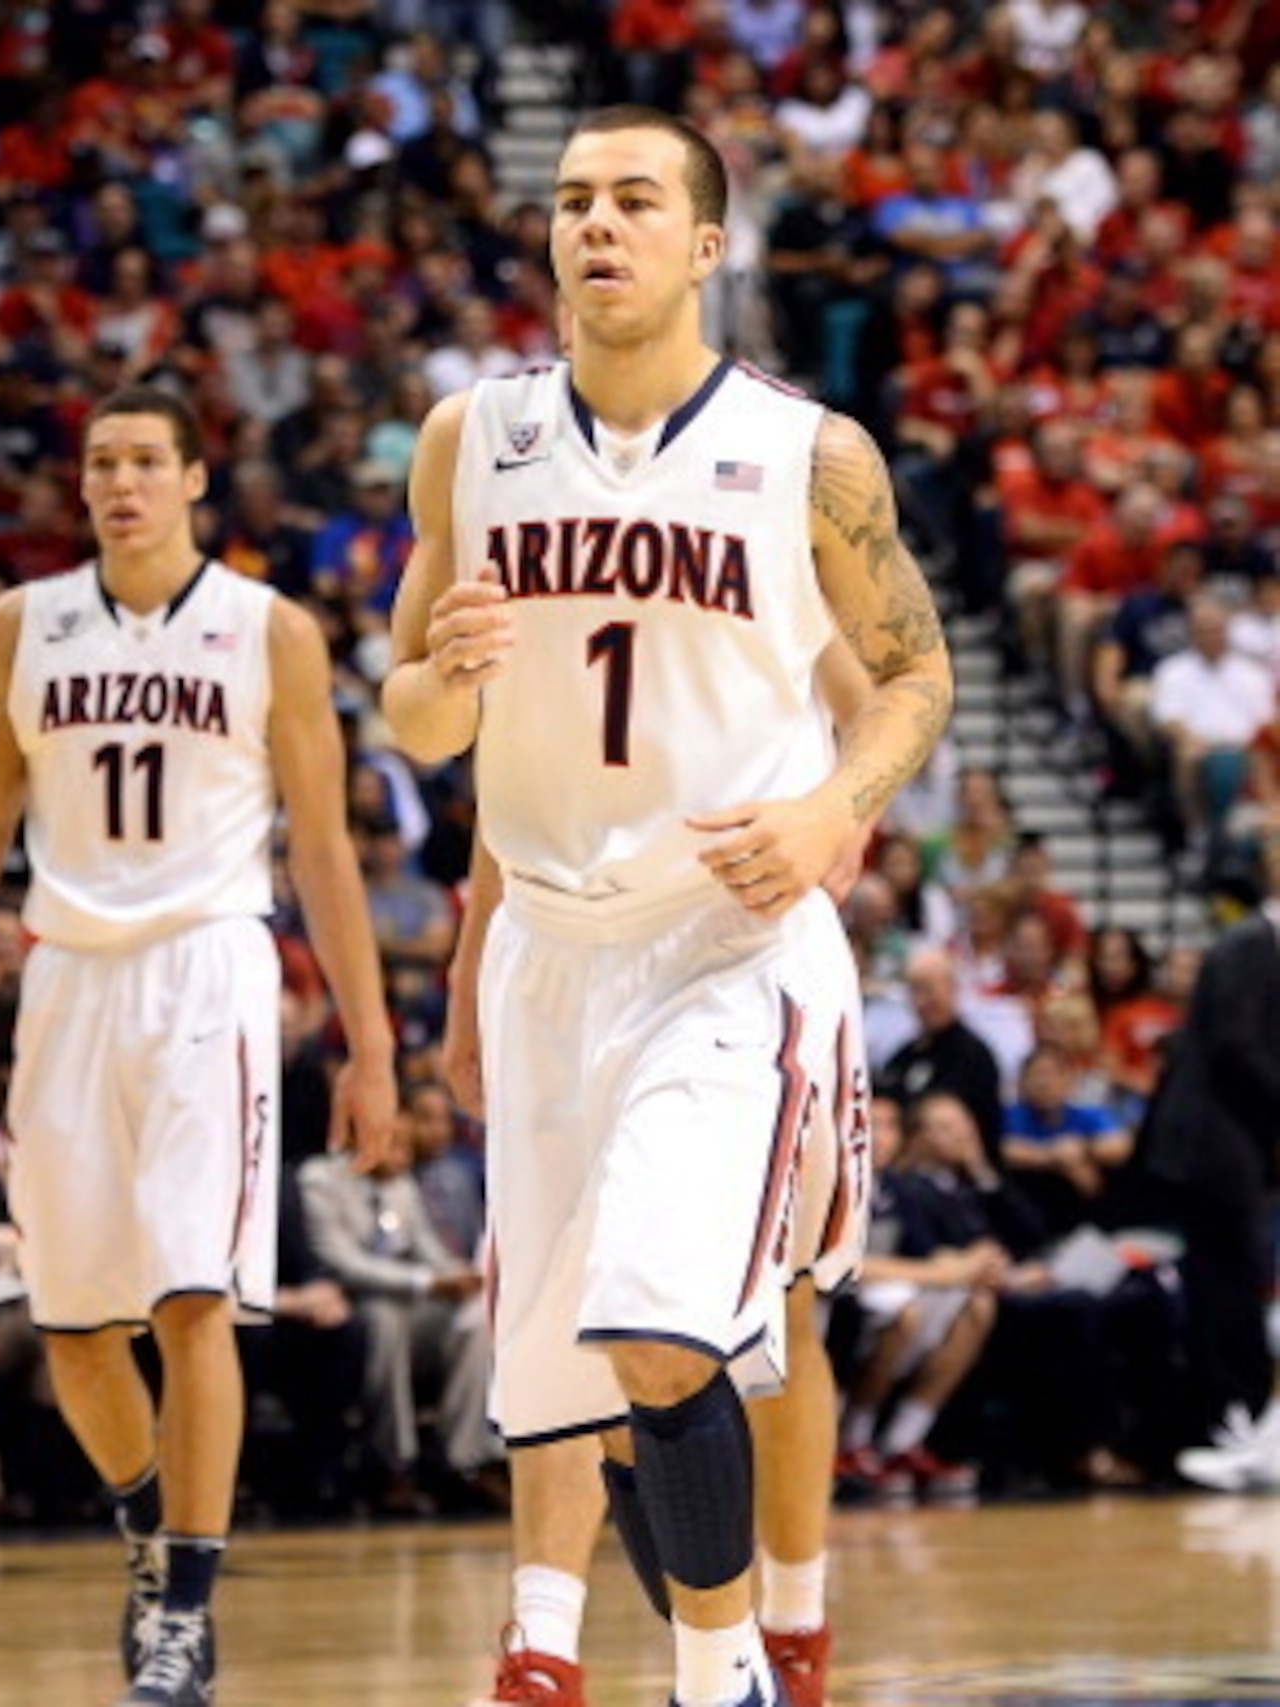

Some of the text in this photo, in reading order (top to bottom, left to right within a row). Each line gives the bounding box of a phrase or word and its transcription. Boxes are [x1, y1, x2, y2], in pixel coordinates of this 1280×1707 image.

[487, 518, 754, 620] ARIZONA
[40, 672, 229, 737] ARIZONA
[586, 621, 637, 767] 1
[92, 742, 164, 841] 11
